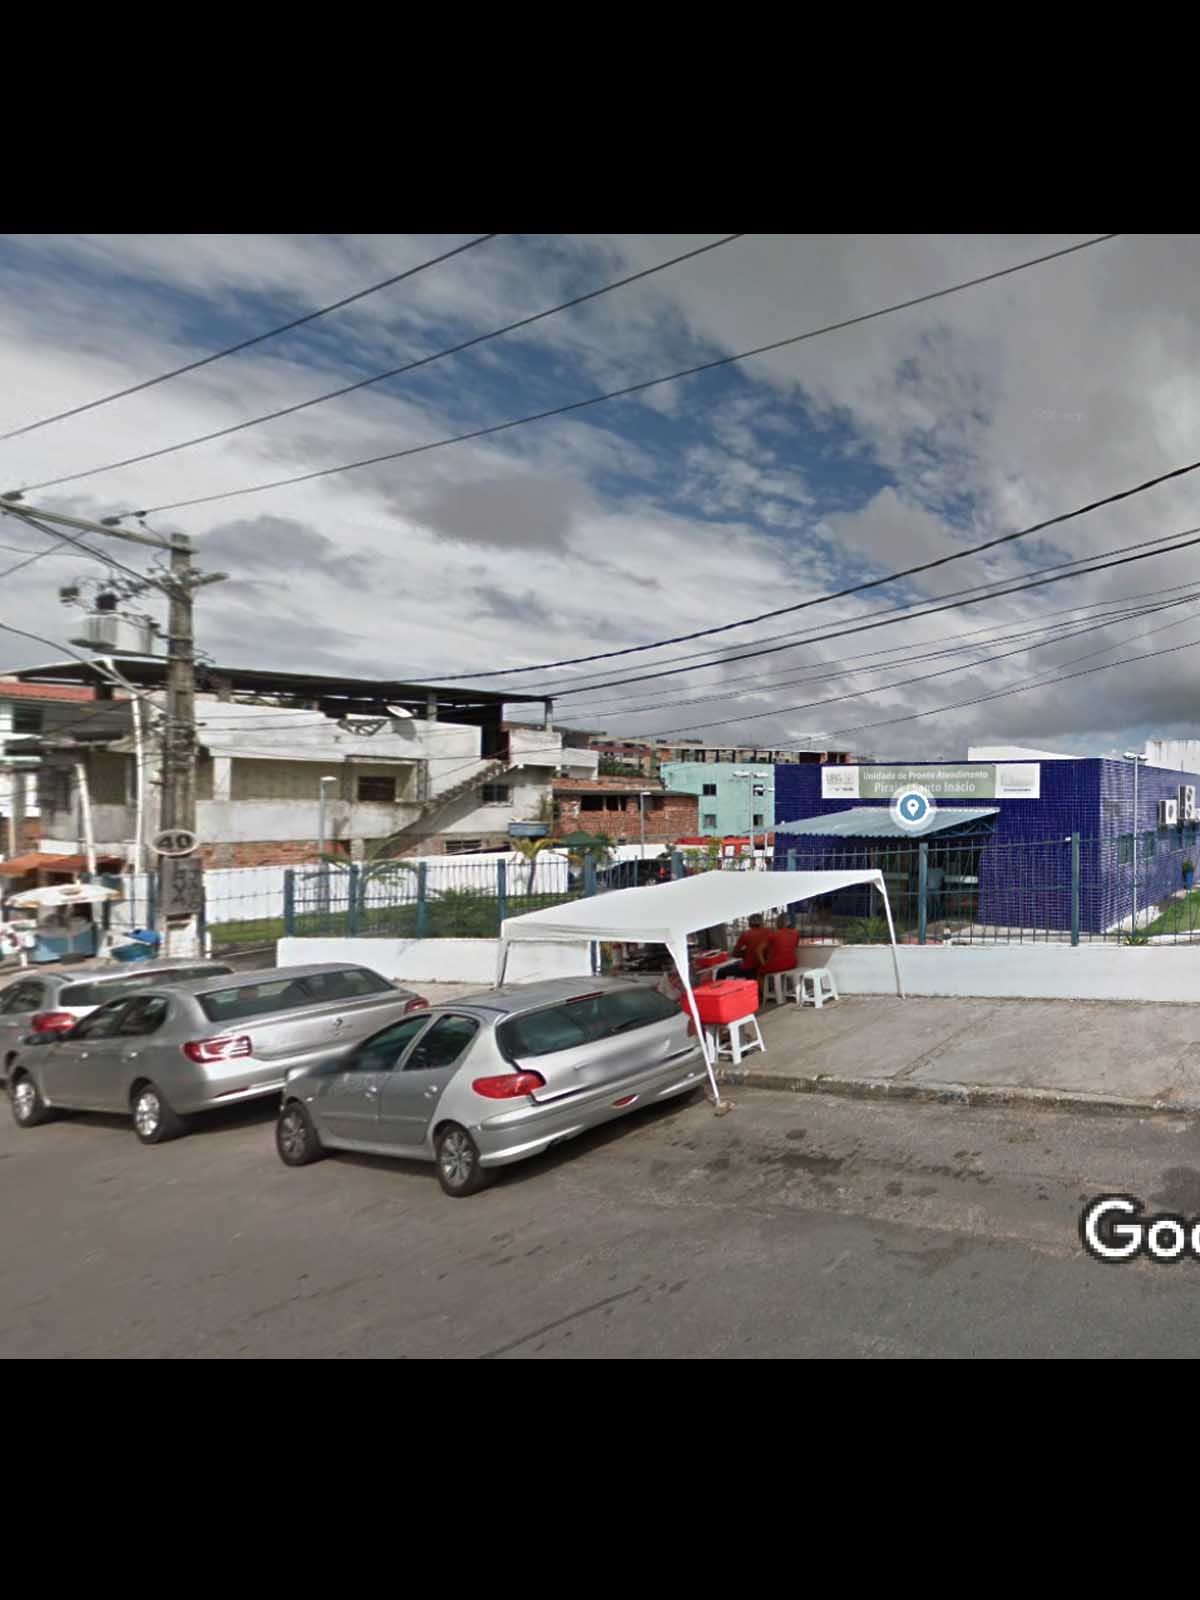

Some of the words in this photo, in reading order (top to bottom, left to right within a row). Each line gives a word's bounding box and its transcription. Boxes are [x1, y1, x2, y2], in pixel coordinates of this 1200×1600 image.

[937, 768, 988, 779] Atendimento
[944, 781, 975, 792] Inácio
[157, 833, 192, 849] 40
